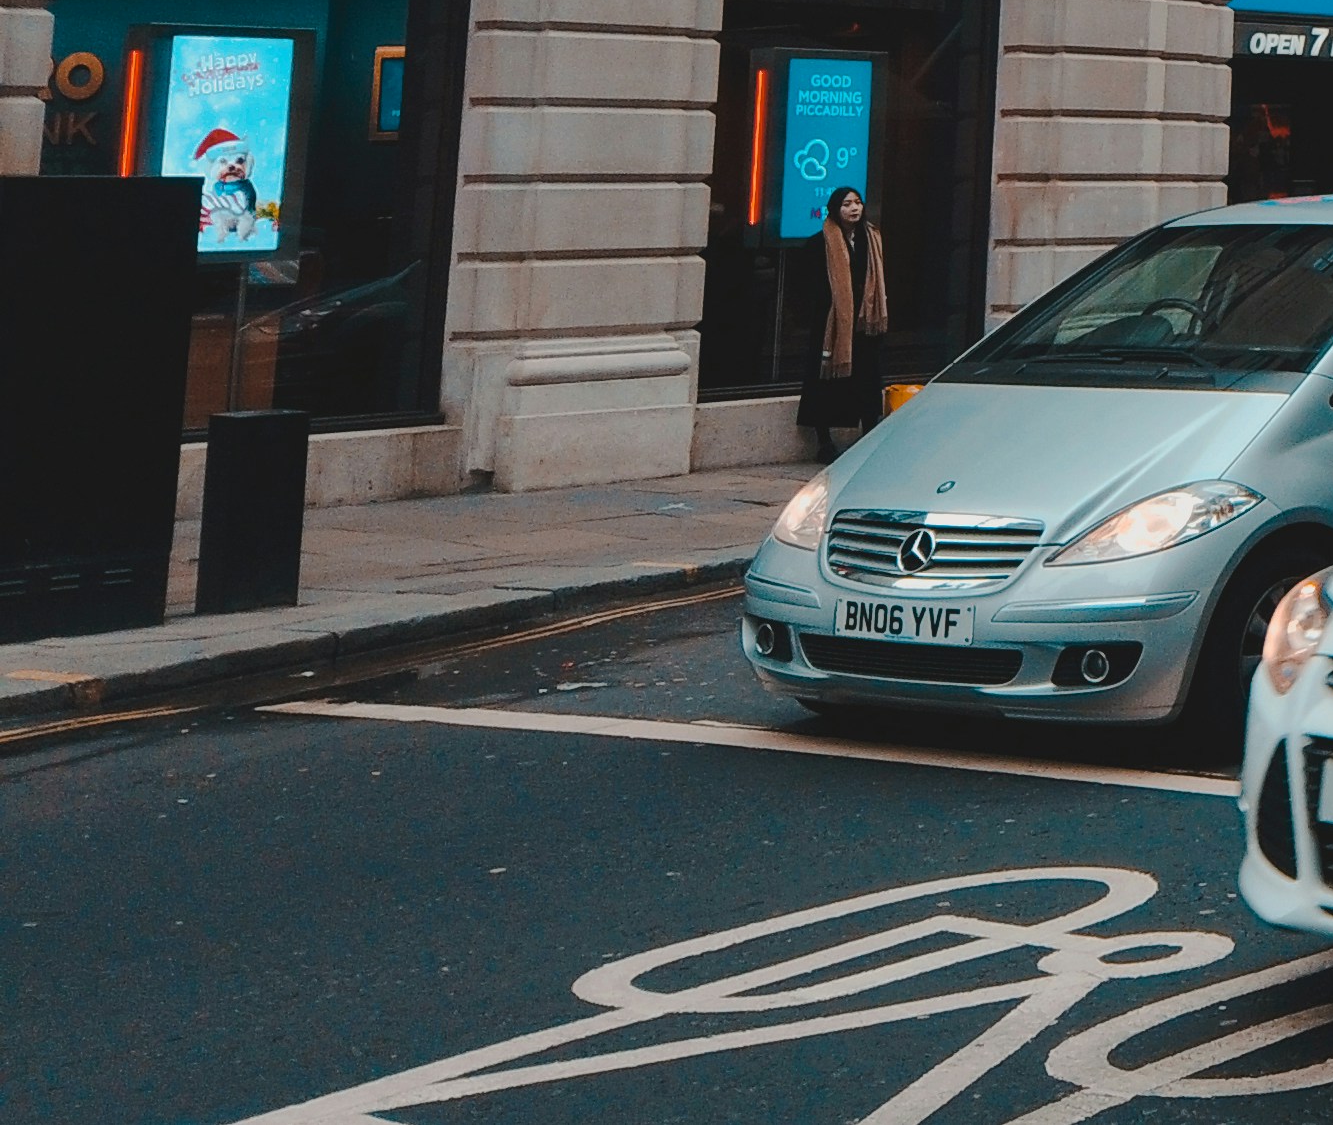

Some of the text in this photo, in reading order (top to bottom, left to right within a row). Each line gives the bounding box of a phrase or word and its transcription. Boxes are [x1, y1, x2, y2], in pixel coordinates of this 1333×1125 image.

[1250, 32, 1306, 56] OPEN
[1310, 27, 1329, 56] 7
[200, 52, 258, 72] Happy
[189, 74, 264, 96] Holidays
[810, 74, 852, 88] GOOD
[798, 90, 863, 105] MORNING
[795, 105, 864, 117] PICCADILLY
[844, 600, 961, 638] BN06 YVF
